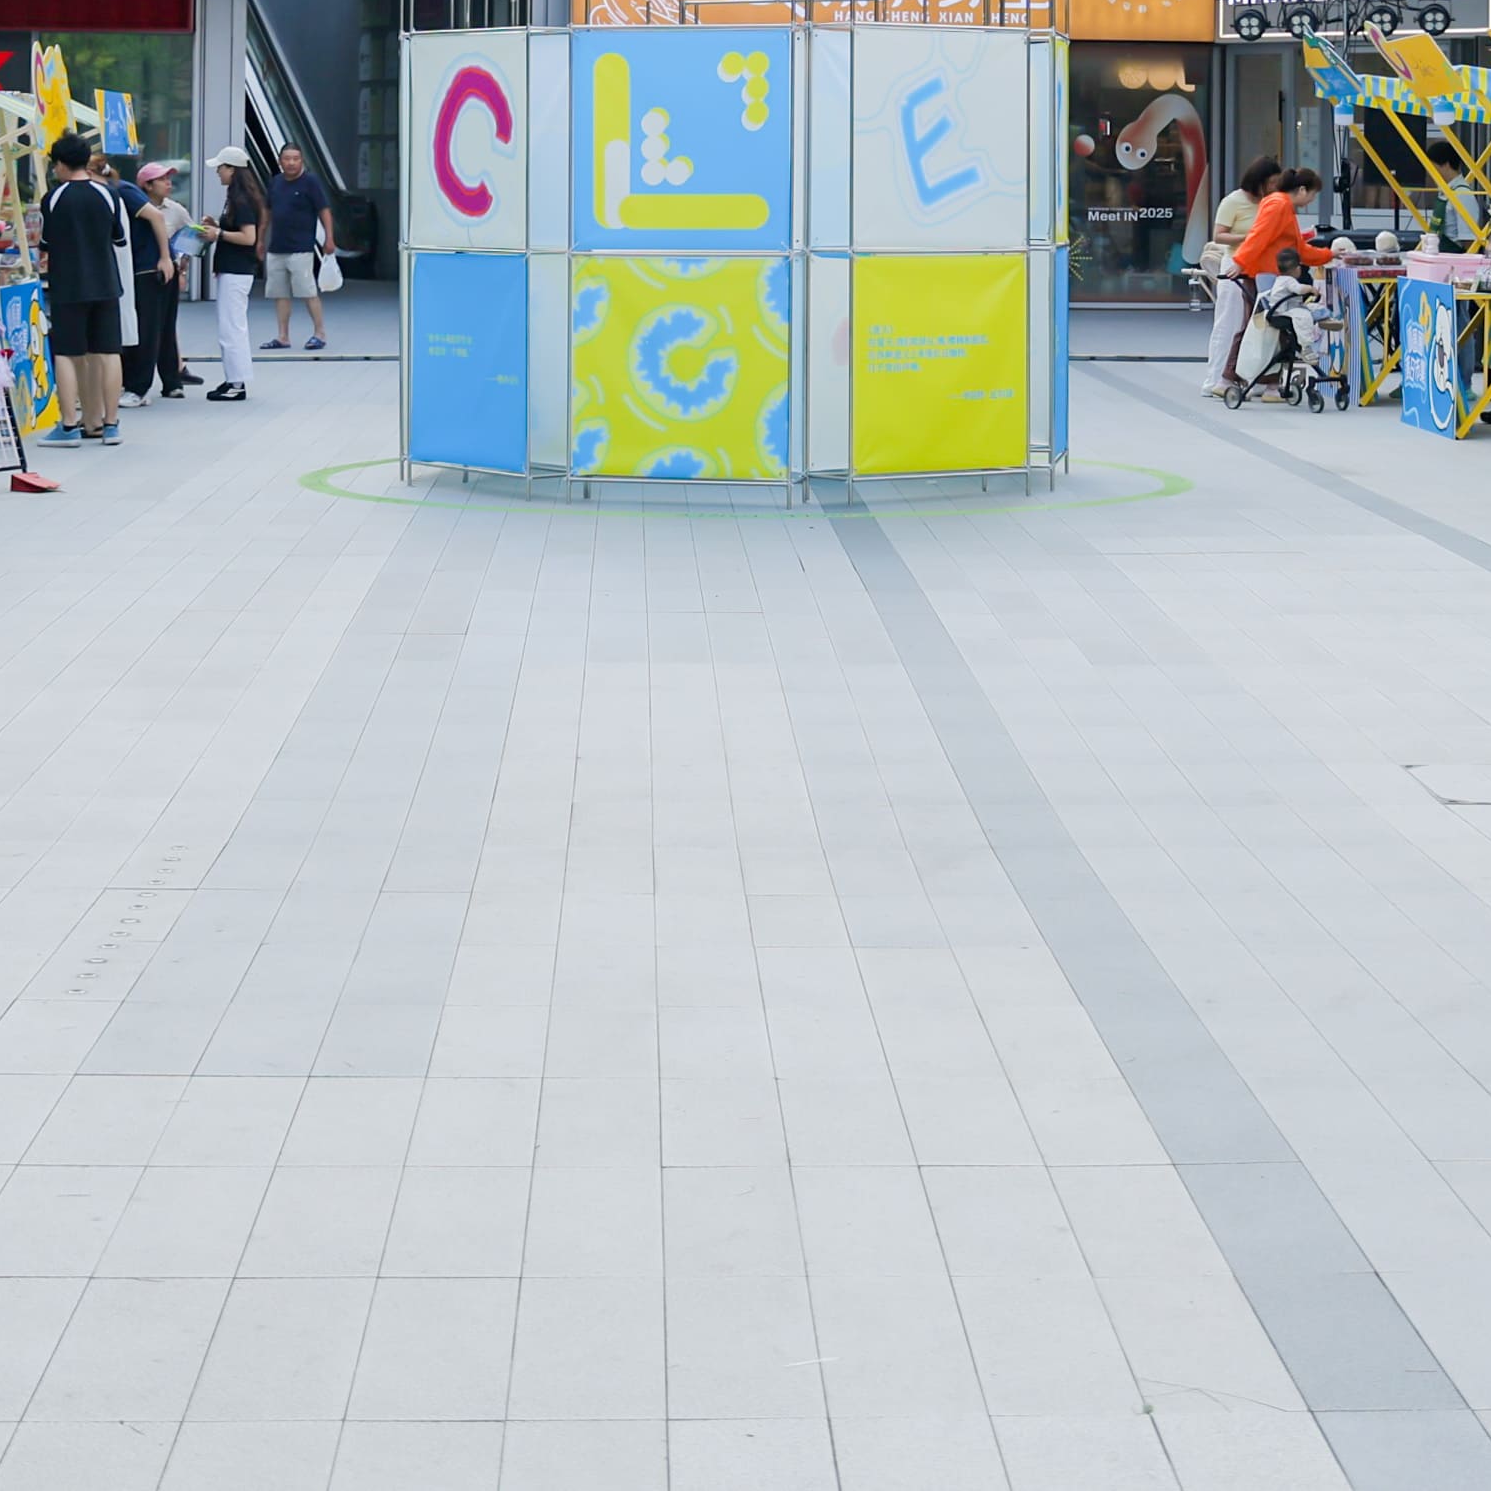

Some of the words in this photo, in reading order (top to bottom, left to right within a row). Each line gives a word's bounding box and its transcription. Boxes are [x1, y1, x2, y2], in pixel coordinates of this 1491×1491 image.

[834, 10, 875, 22] HANG
[938, 11, 974, 24] XIAN
[900, 75, 981, 207] E
[1088, 210, 1120, 222] Meet
[1124, 210, 1138, 222] IN
[1139, 207, 1173, 219] 2025
